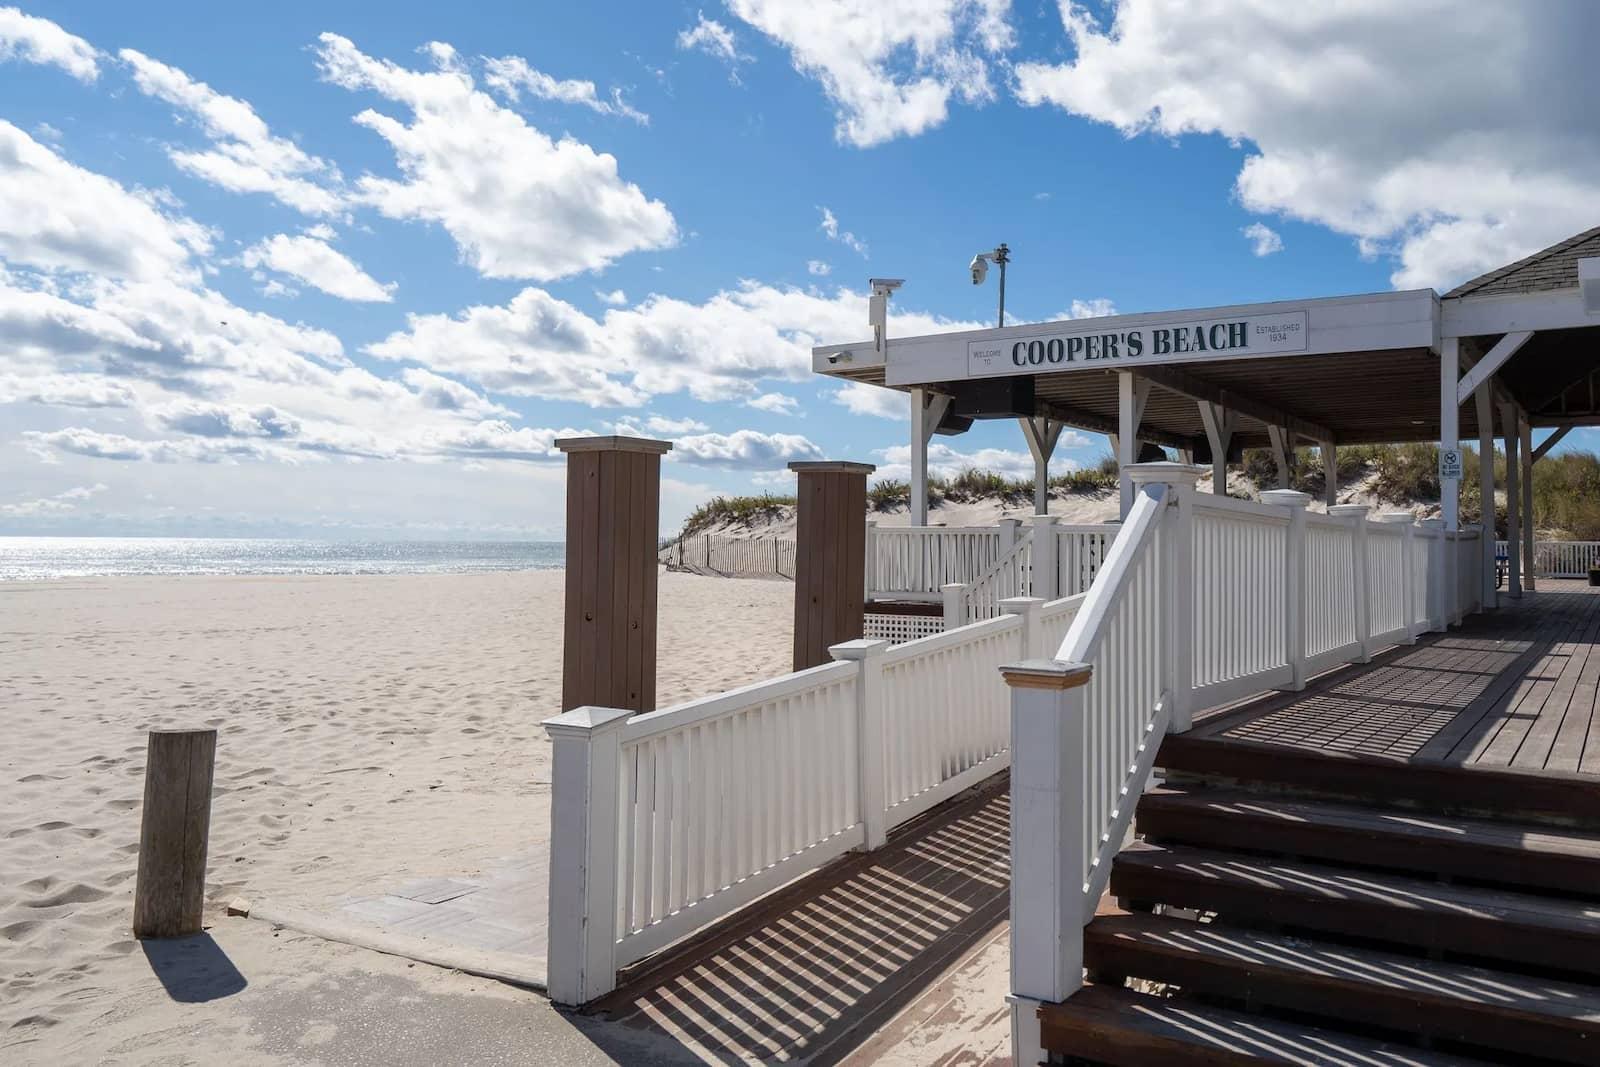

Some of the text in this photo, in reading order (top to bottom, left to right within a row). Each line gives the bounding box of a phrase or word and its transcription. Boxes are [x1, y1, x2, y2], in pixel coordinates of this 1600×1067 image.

[1256, 323, 1300, 334] ESTABLISHED
[1270, 332, 1287, 342] 1934
[1012, 322, 1248, 366] COOPER'S BEACH
[973, 350, 1001, 358] WELCOME
